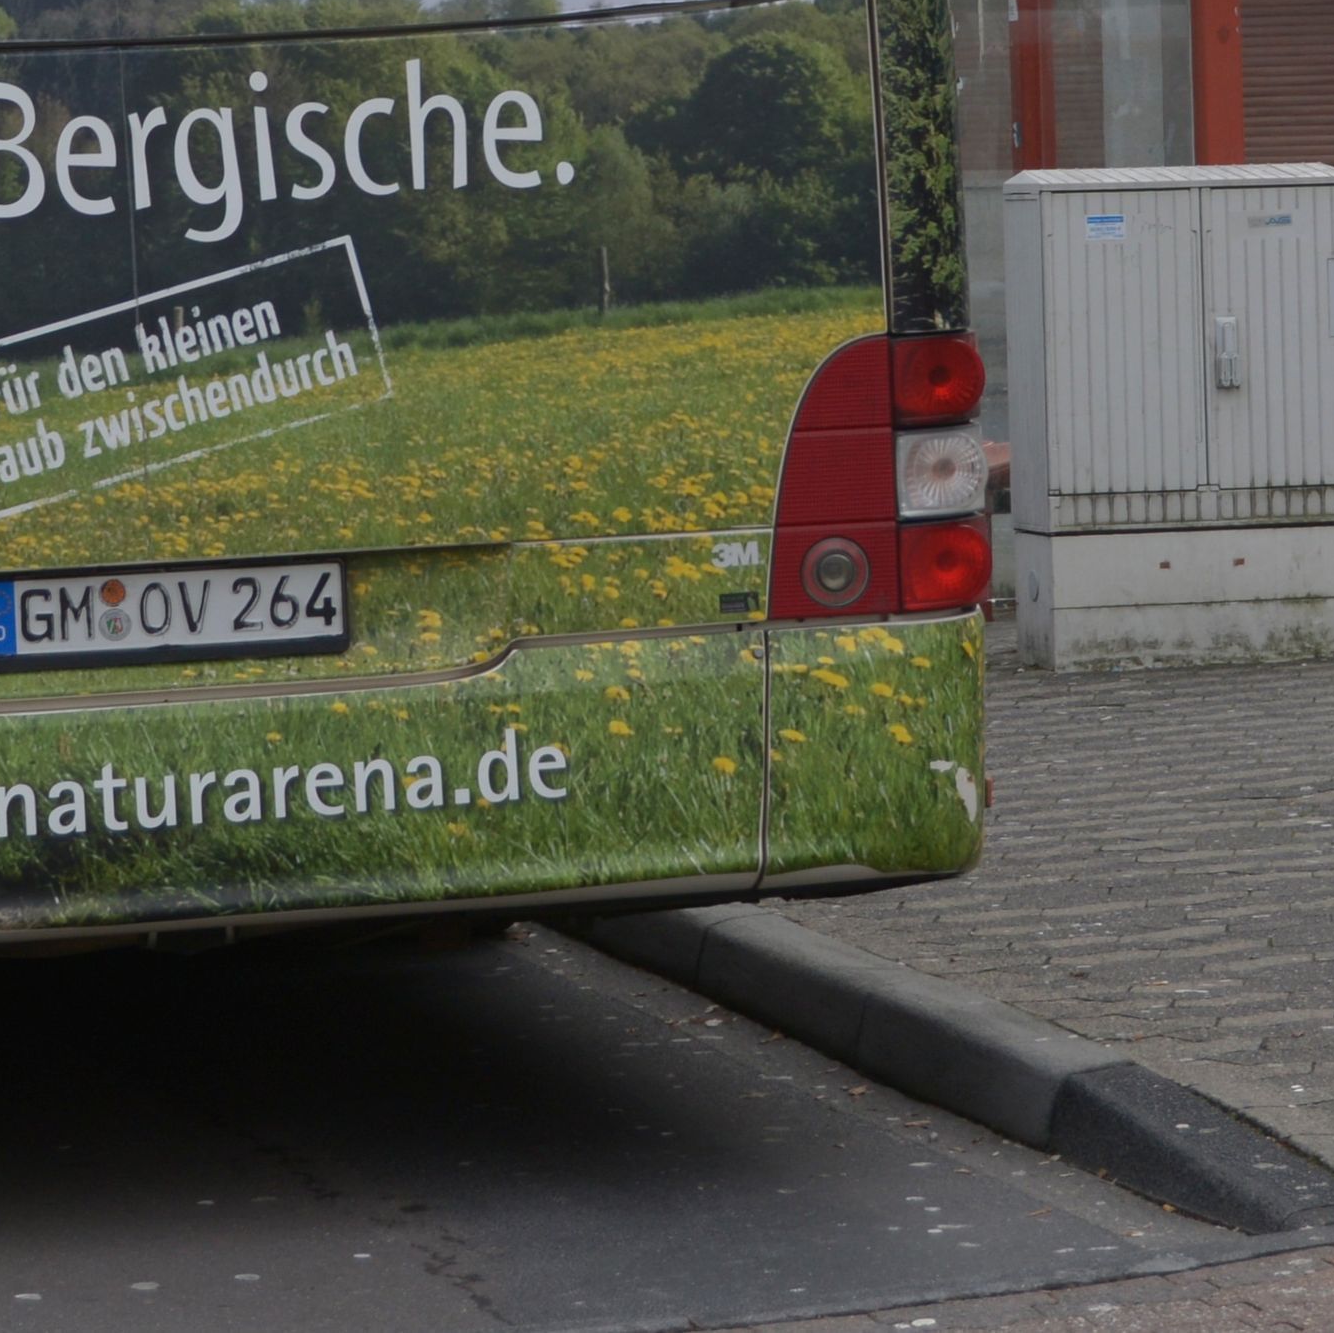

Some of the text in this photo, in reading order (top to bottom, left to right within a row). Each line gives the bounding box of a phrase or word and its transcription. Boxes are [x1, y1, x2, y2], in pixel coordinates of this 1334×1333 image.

[57, 344, 130, 400] den
[134, 299, 282, 375] kleinen
[77, 329, 360, 460] zwischendurch
[711, 540, 760, 568] 3M
[20, 585, 96, 644] GM
[139, 578, 212, 636] OV
[232, 571, 338, 633] 264
